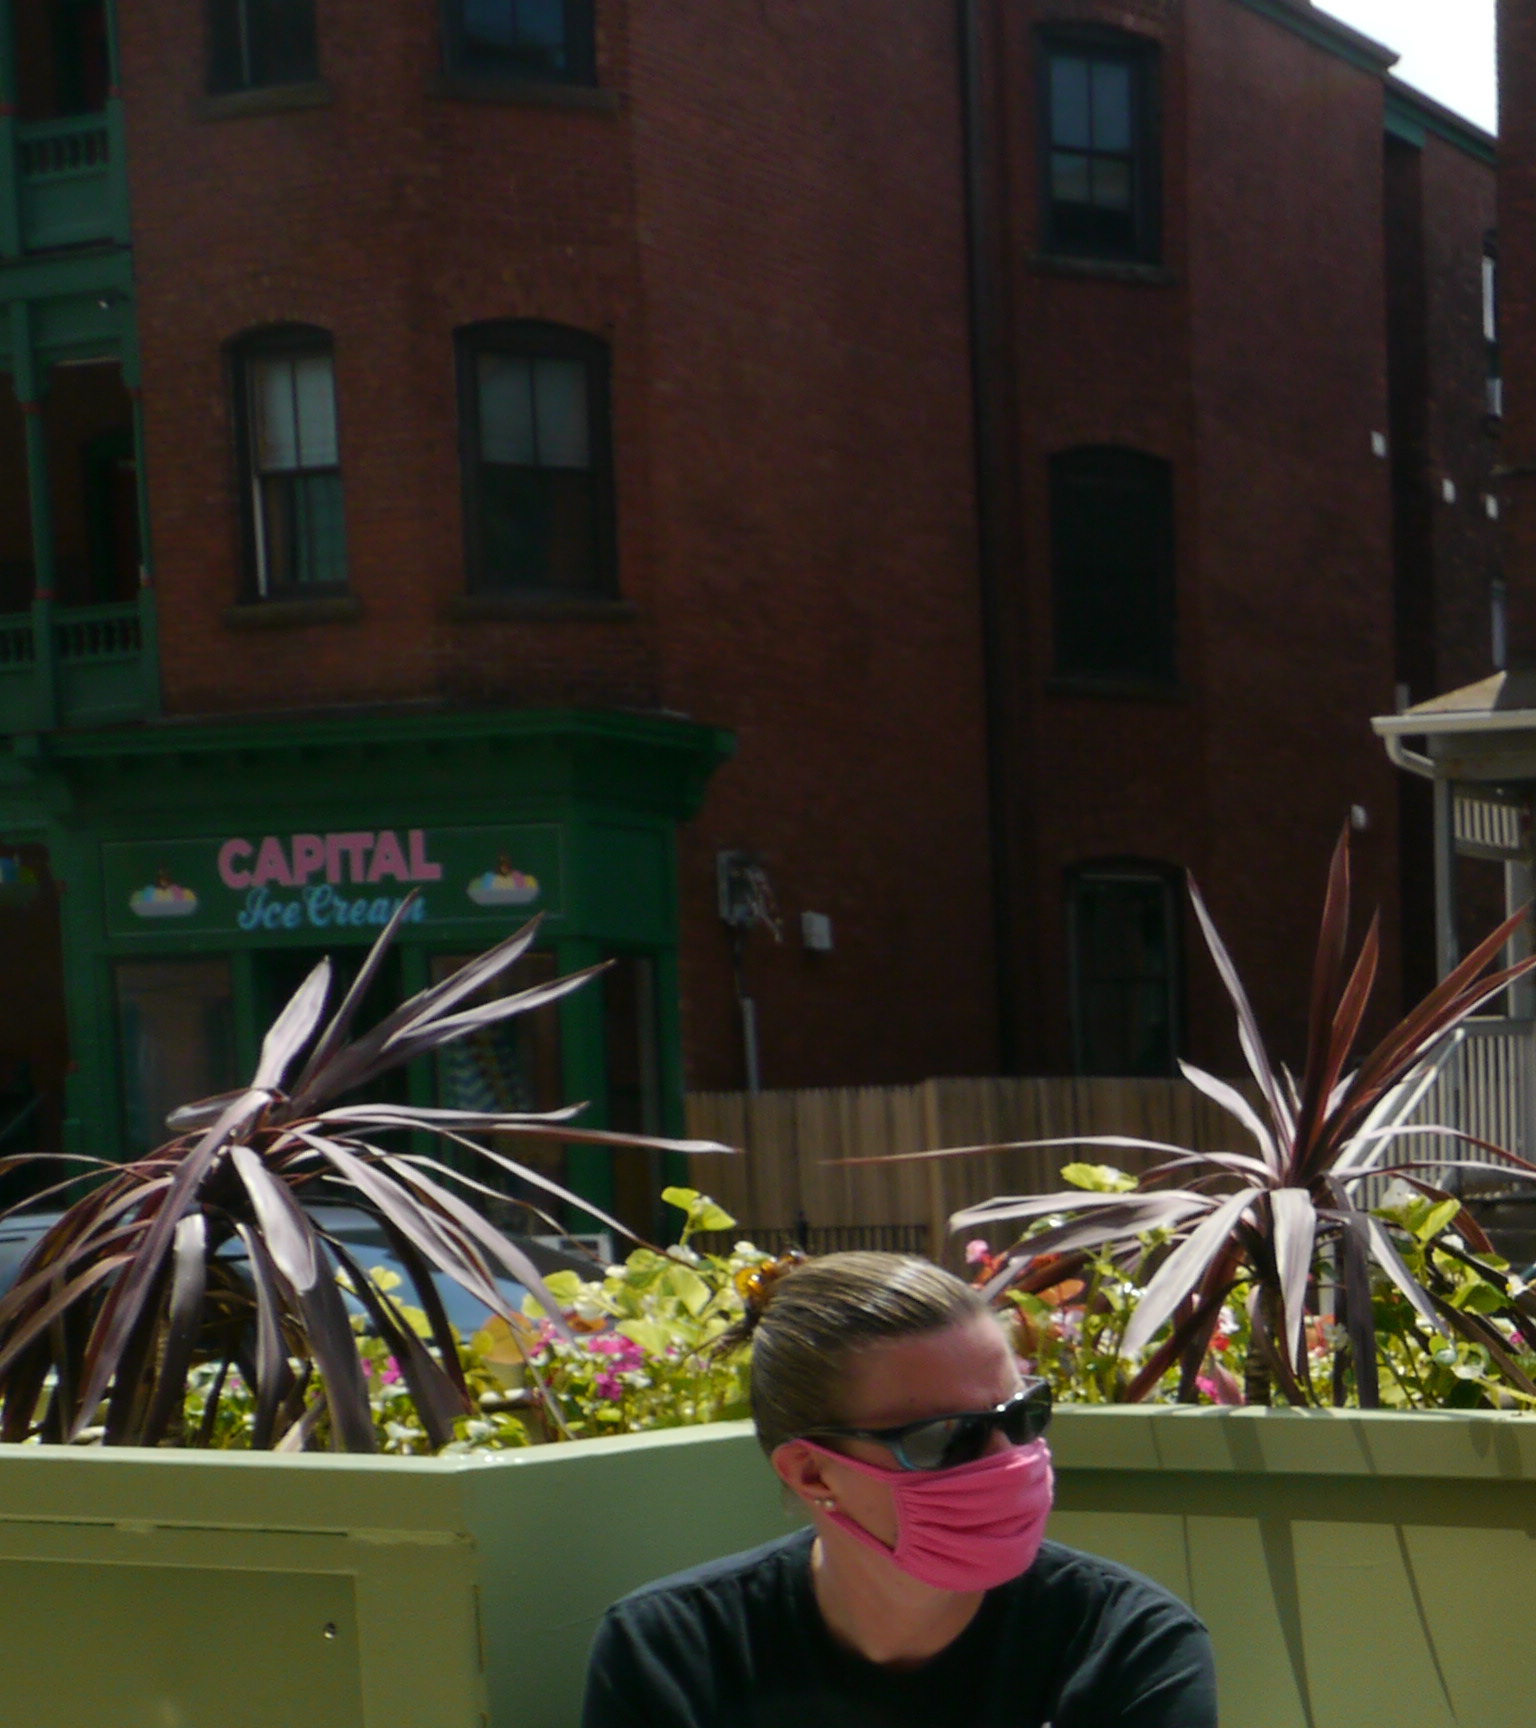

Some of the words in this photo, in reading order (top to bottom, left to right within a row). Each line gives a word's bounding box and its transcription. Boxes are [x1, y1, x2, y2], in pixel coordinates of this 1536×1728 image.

[217, 829, 442, 888] CAPITAL
[237, 887, 301, 930] Ice
[307, 886, 425, 927] Cream
